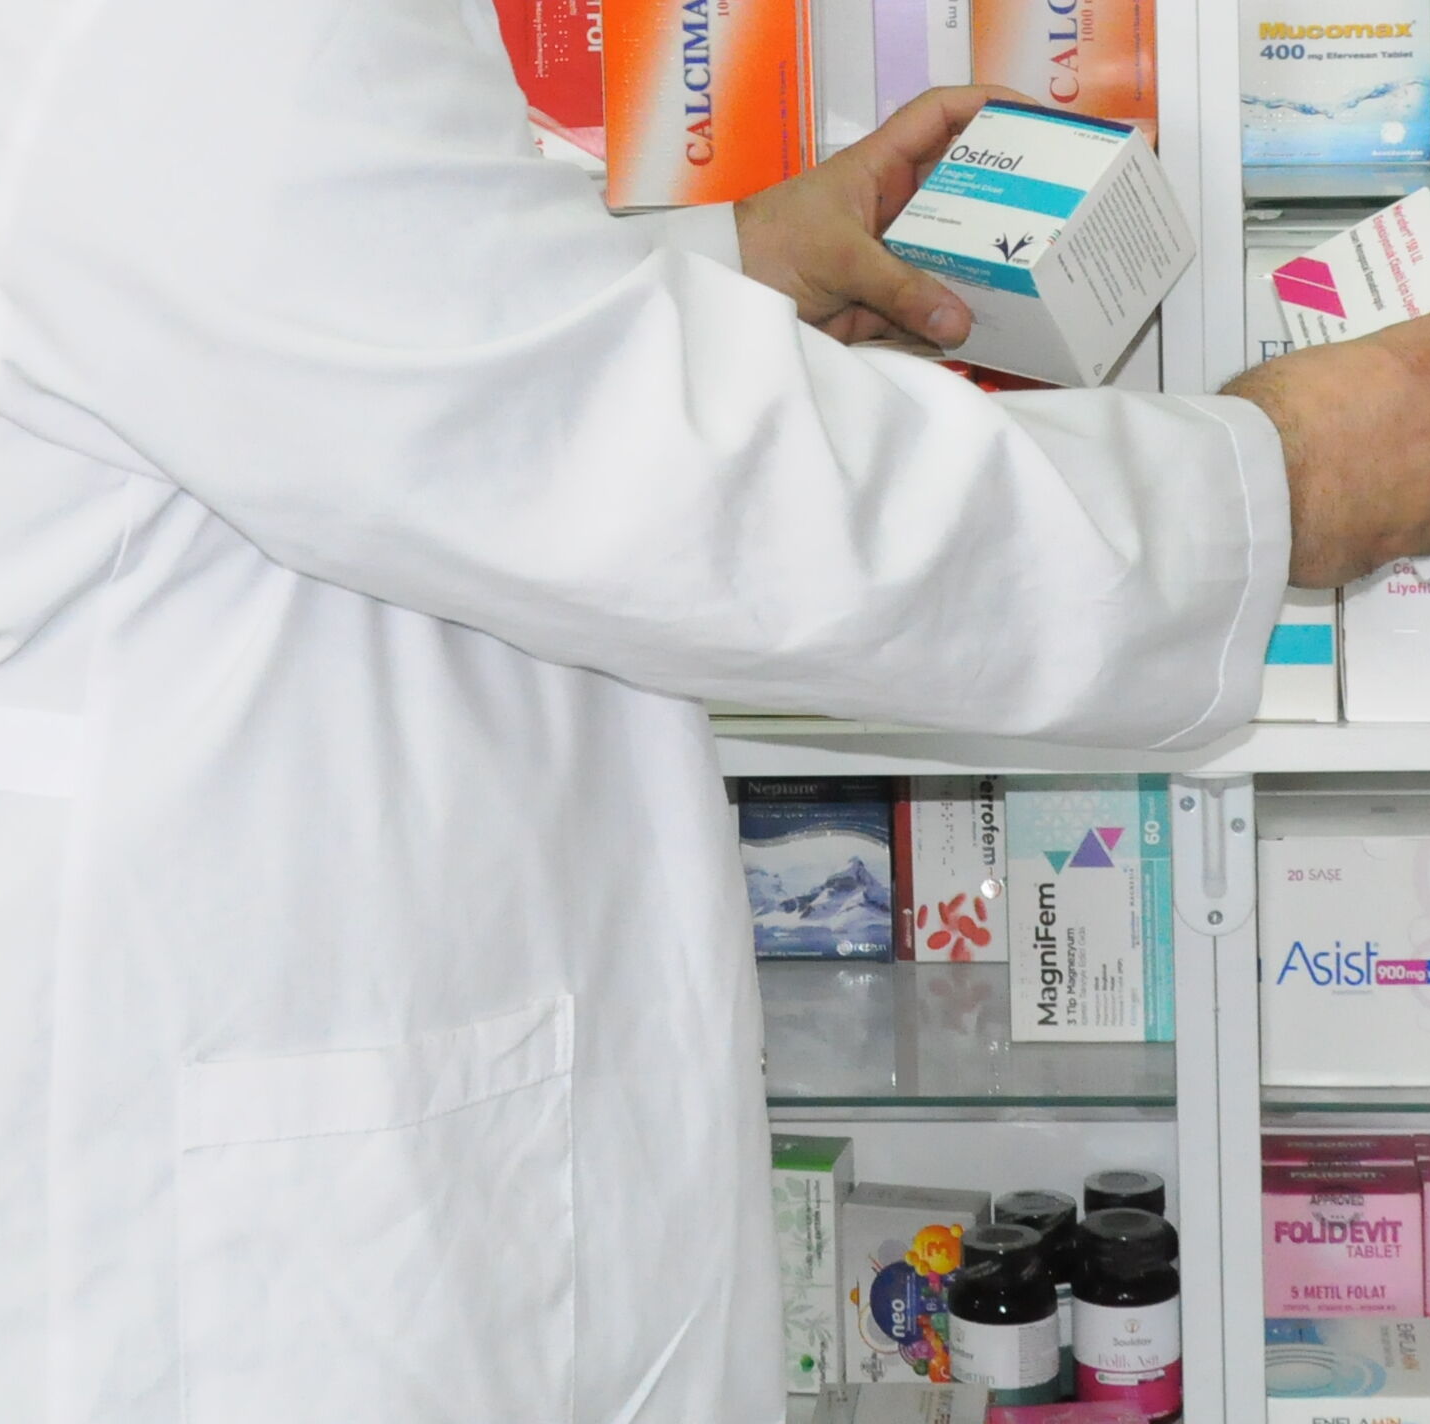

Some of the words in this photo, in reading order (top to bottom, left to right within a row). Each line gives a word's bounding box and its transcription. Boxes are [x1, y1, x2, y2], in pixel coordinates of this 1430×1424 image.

[1082, 8, 1094, 43] 1000
[1259, 21, 1412, 39] Mucomax
[949, 144, 1023, 171] Ostriol
[1034, 883, 1063, 1026] MagniFem
[1276, 941, 1374, 988] Asist
[1346, 1285, 1387, 1300] FOLAT
[892, 1298, 906, 1337] neo
